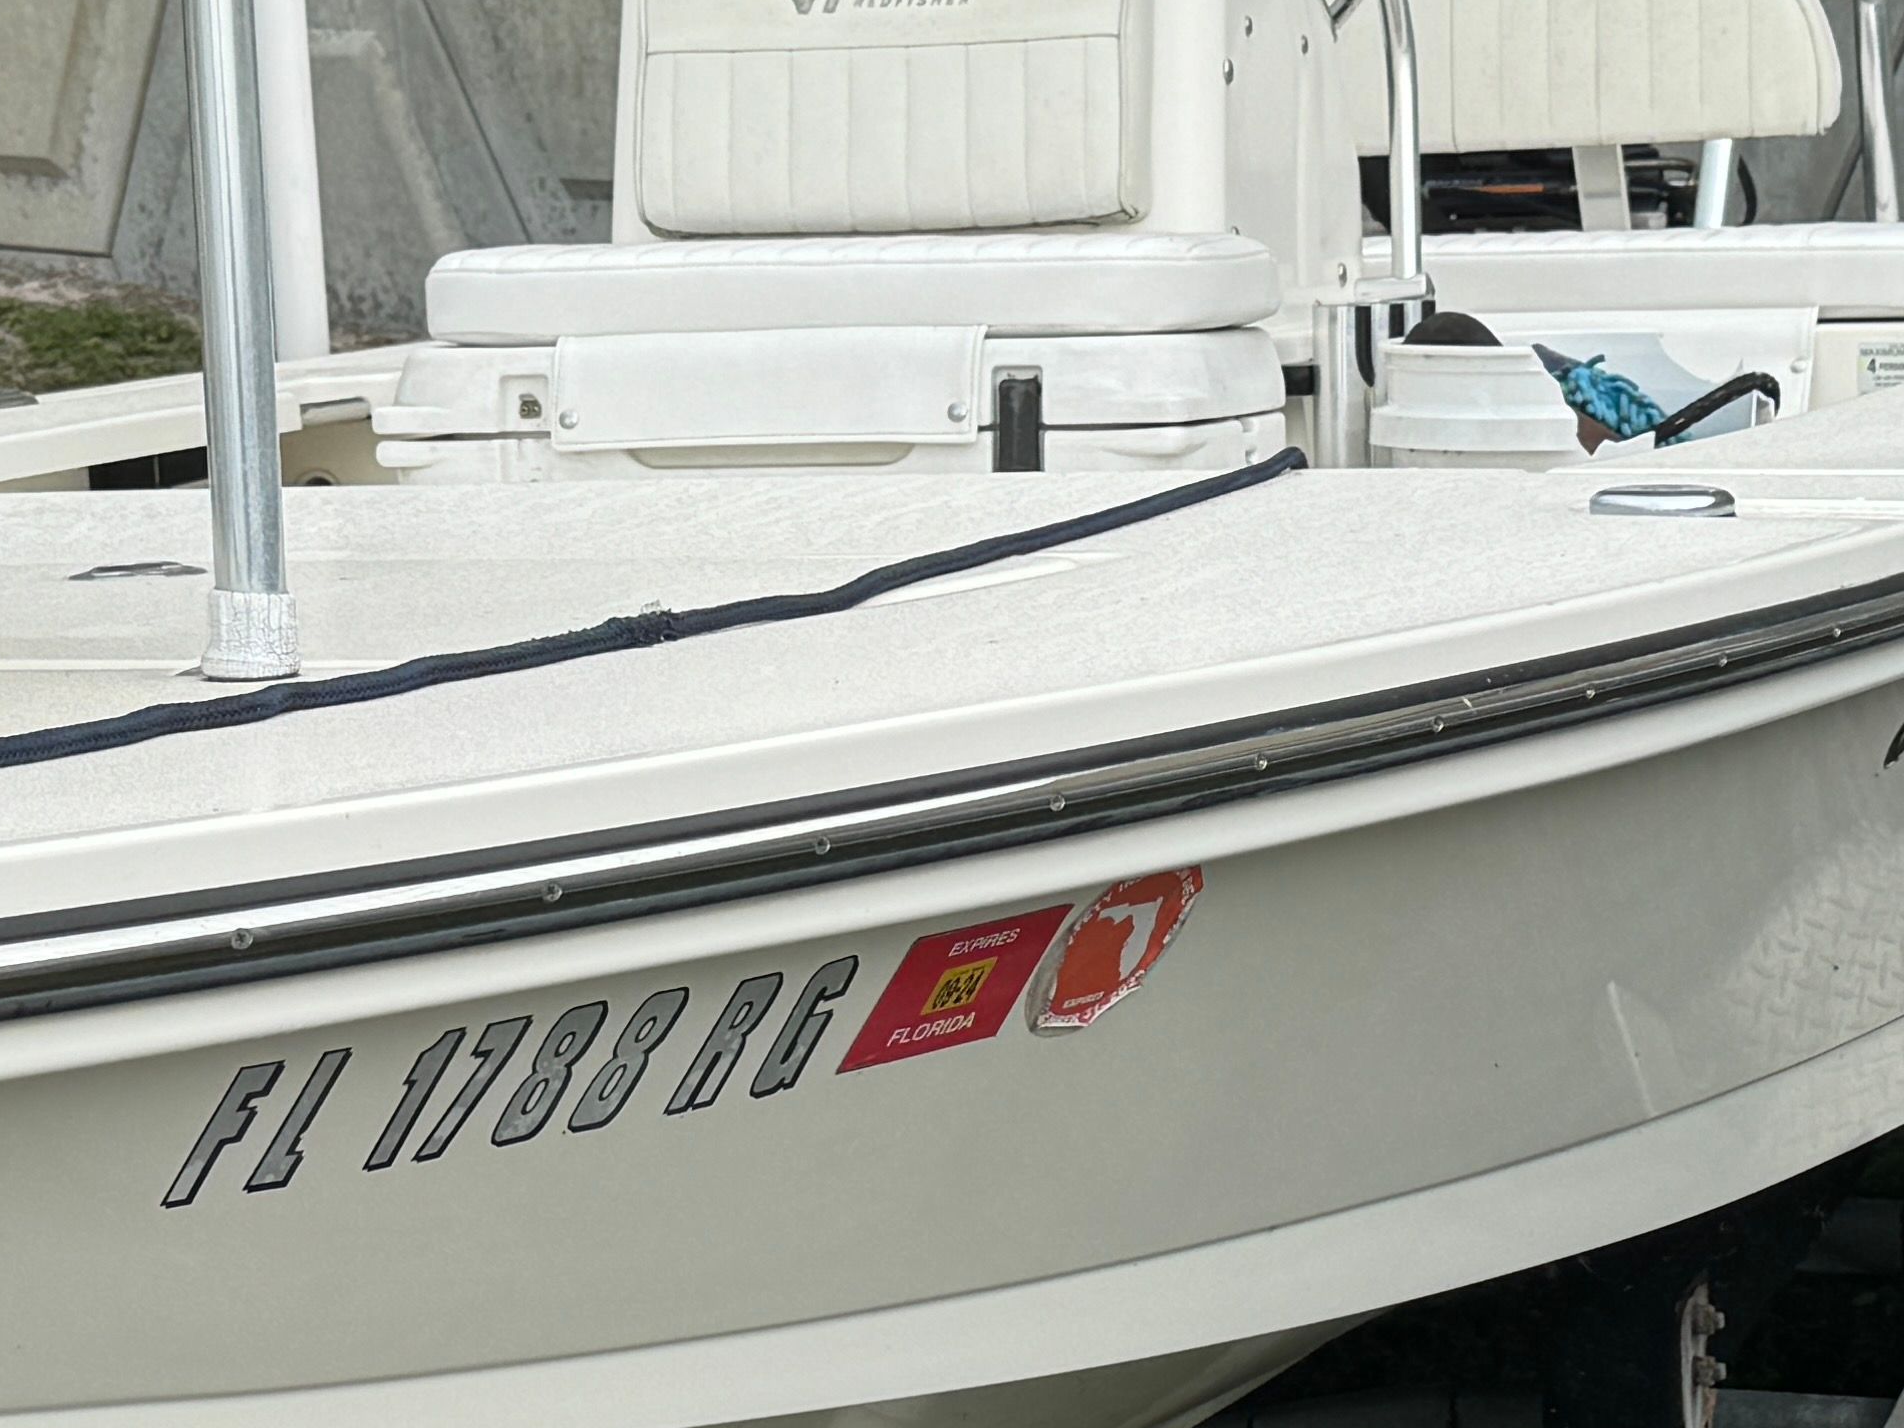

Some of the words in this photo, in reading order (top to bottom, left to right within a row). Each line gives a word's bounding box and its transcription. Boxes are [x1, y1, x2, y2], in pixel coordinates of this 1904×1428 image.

[1867, 358, 1876, 374] 4
[948, 928, 1021, 957] EXPIRES
[886, 1012, 976, 1047] FLORIDA
[160, 1047, 352, 1209] FL
[362, 987, 689, 1172] 1788
[662, 955, 858, 1115] RG
